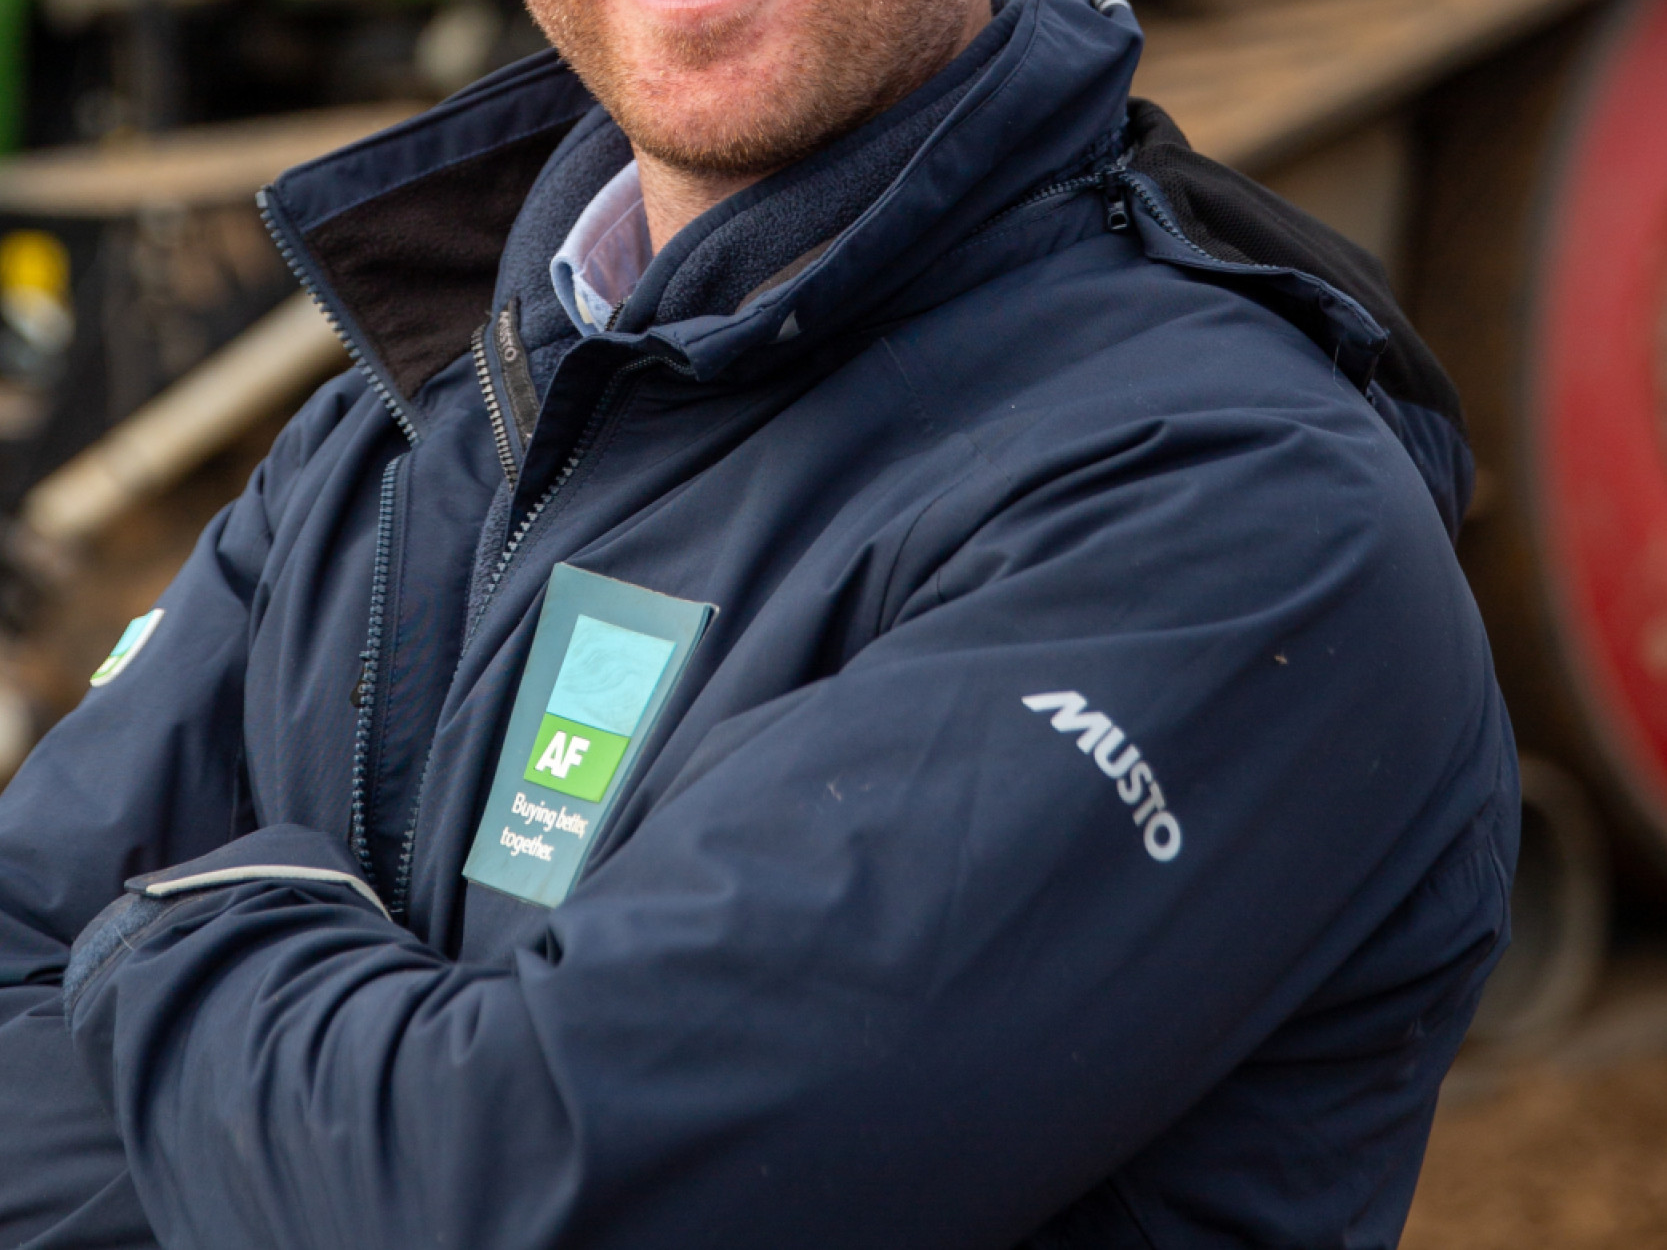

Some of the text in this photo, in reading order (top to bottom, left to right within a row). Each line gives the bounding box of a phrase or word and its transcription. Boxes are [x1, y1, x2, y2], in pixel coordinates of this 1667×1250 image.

[534, 730, 591, 779] AF
[1020, 690, 1182, 863] MUSTO
[511, 791, 558, 832] Buying
